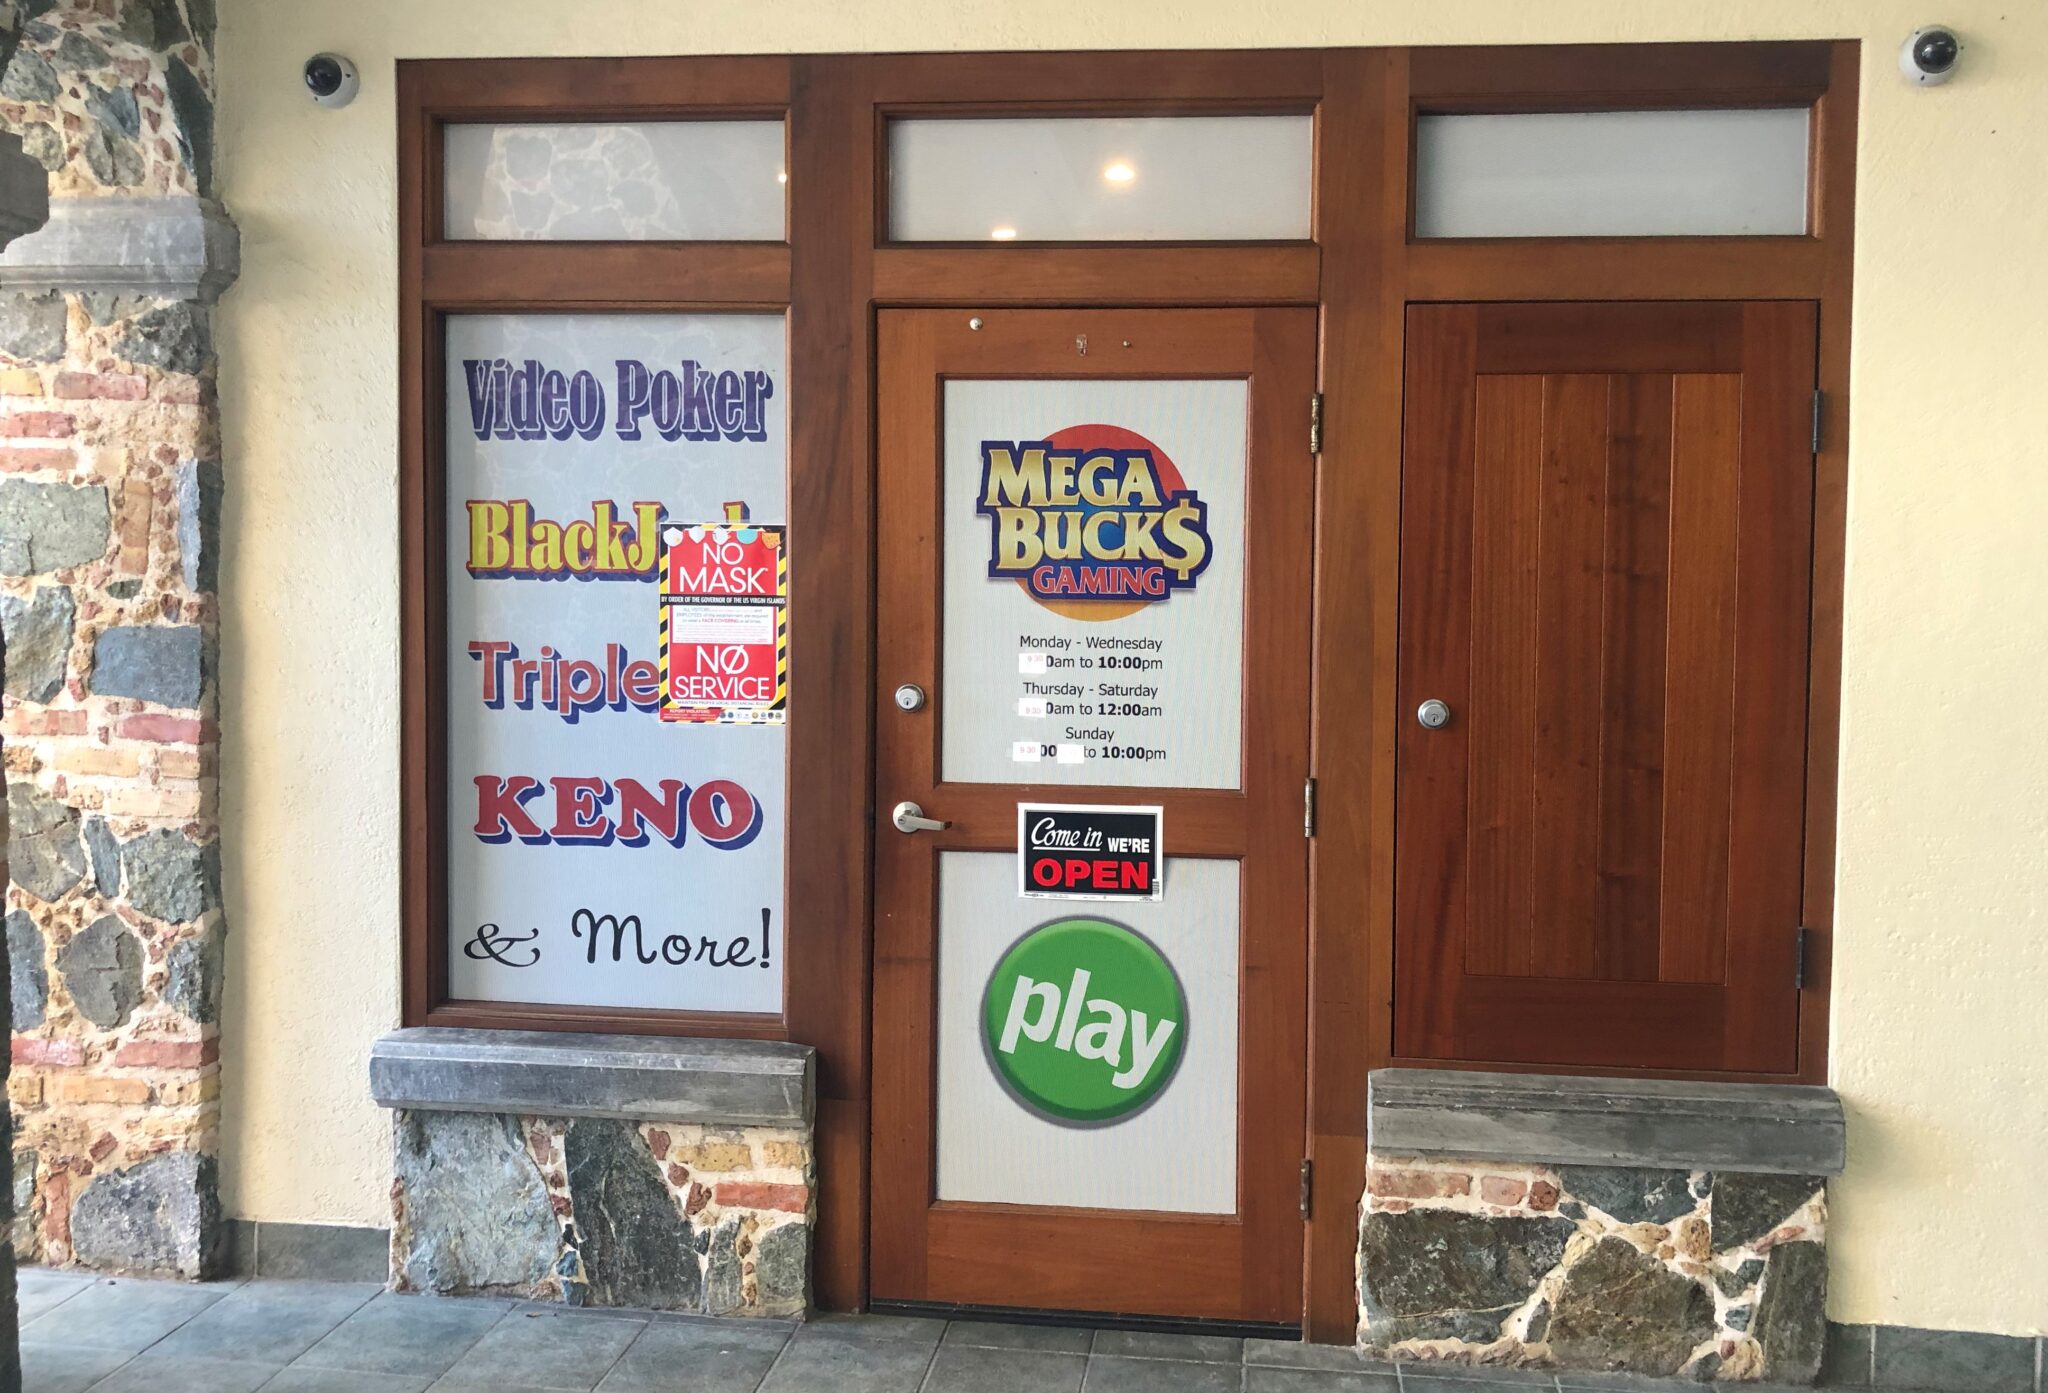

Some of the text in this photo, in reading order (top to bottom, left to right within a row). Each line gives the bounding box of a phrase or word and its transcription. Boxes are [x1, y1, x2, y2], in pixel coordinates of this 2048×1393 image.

[462, 358, 774, 442] Video Poker
[983, 449, 1162, 507] MEGA
[466, 499, 750, 582] BlackJ
[702, 542, 744, 565] NO
[679, 566, 769, 593] MASK
[1032, 565, 1166, 595] GAMING
[726, 596, 733, 604] OF
[1020, 635, 1072, 651] Monday
[1086, 636, 1163, 652] Wednesday
[1079, 657, 1093, 669] to
[1098, 656, 1163, 672] 10:00pm
[468, 640, 659, 725] Triple
[674, 675, 770, 700] SERVICE
[1023, 682, 1085, 698] Thursday
[1098, 683, 1158, 699] Saturday
[1079, 704, 1093, 716] to
[1098, 703, 1162, 717] 12:00am
[1065, 726, 1115, 743] Sunday
[1084, 746, 1166, 762] to 10:00pm
[473, 775, 764, 851] KENO
[1031, 817, 1150, 853] Come in WE'RE
[1032, 857, 1149, 890] OPEN
[463, 908, 771, 969] & More!
[998, 967, 1177, 1090] play
